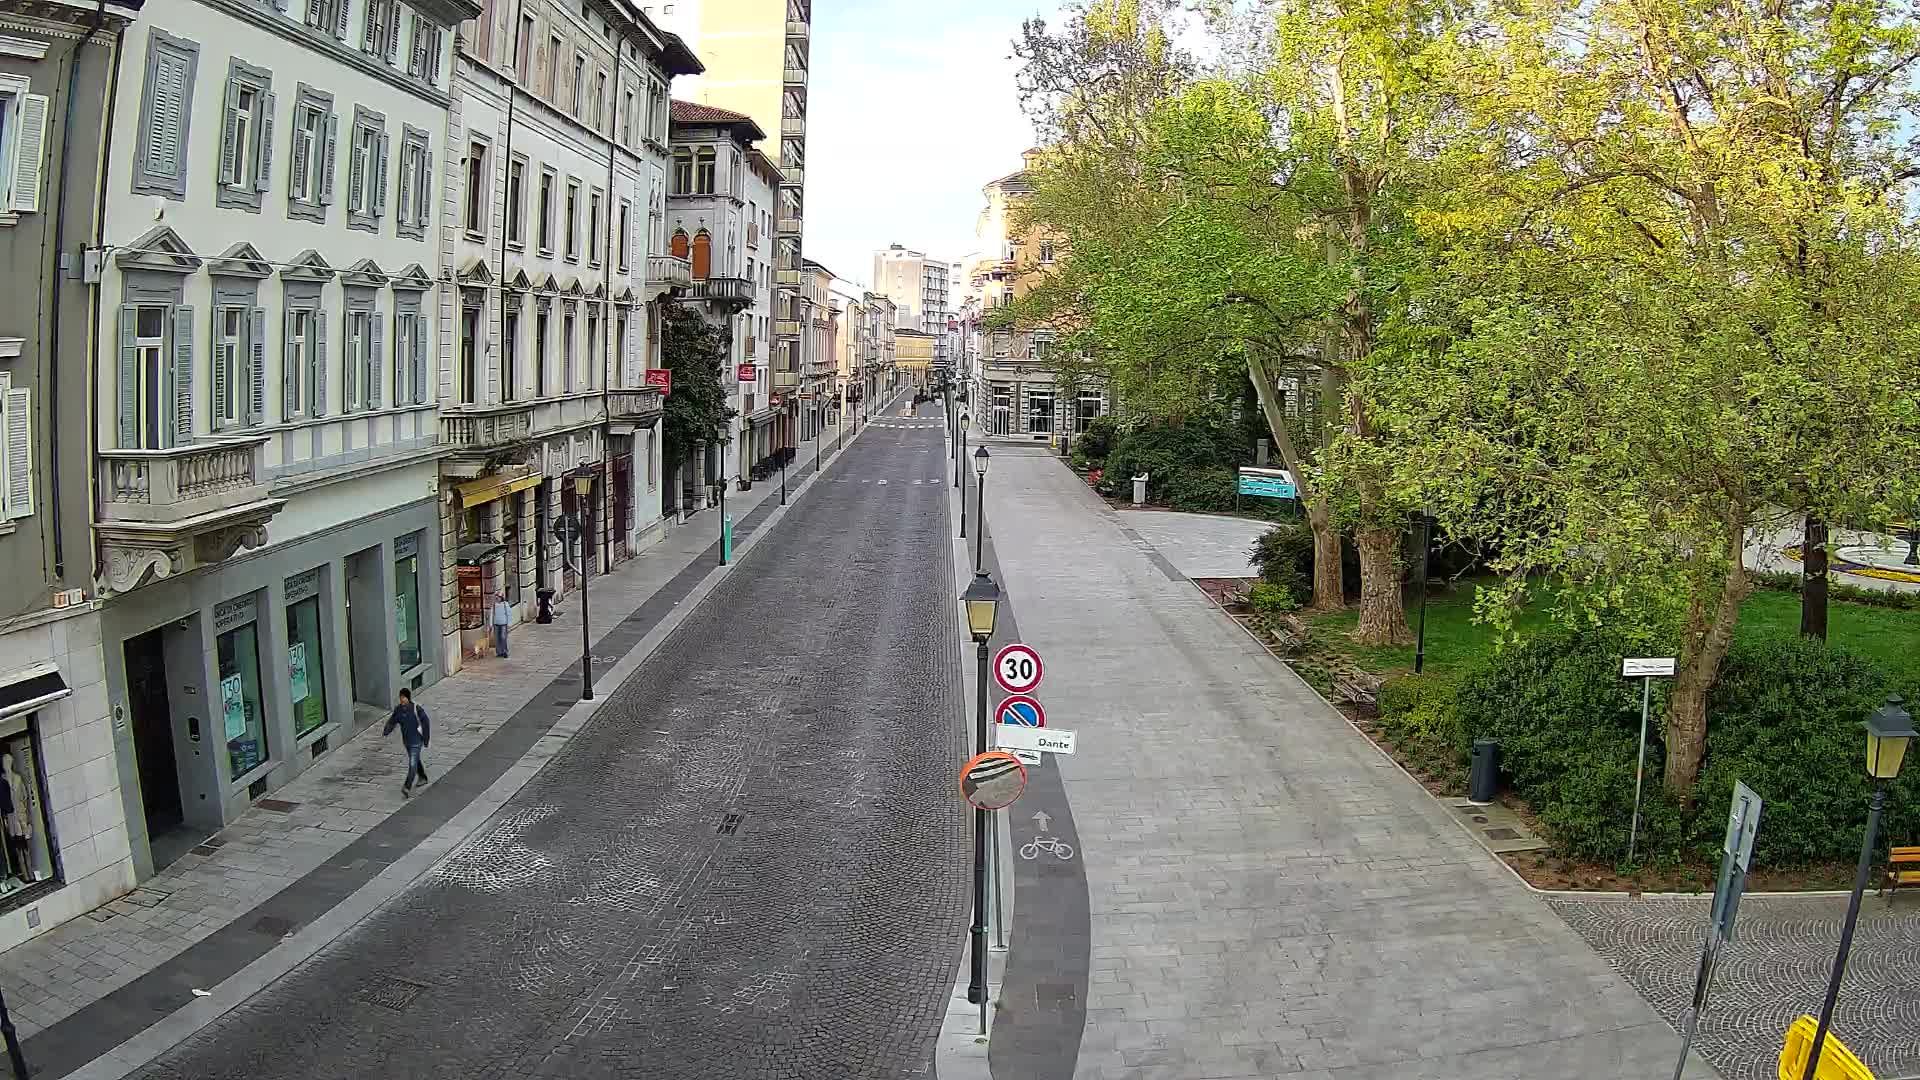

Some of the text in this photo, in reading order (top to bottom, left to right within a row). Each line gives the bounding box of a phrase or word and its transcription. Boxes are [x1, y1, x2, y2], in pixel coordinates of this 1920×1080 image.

[1005, 658, 1033, 680] 30
[223, 677, 241, 700] 130
[1038, 737, 1070, 749] Dante
